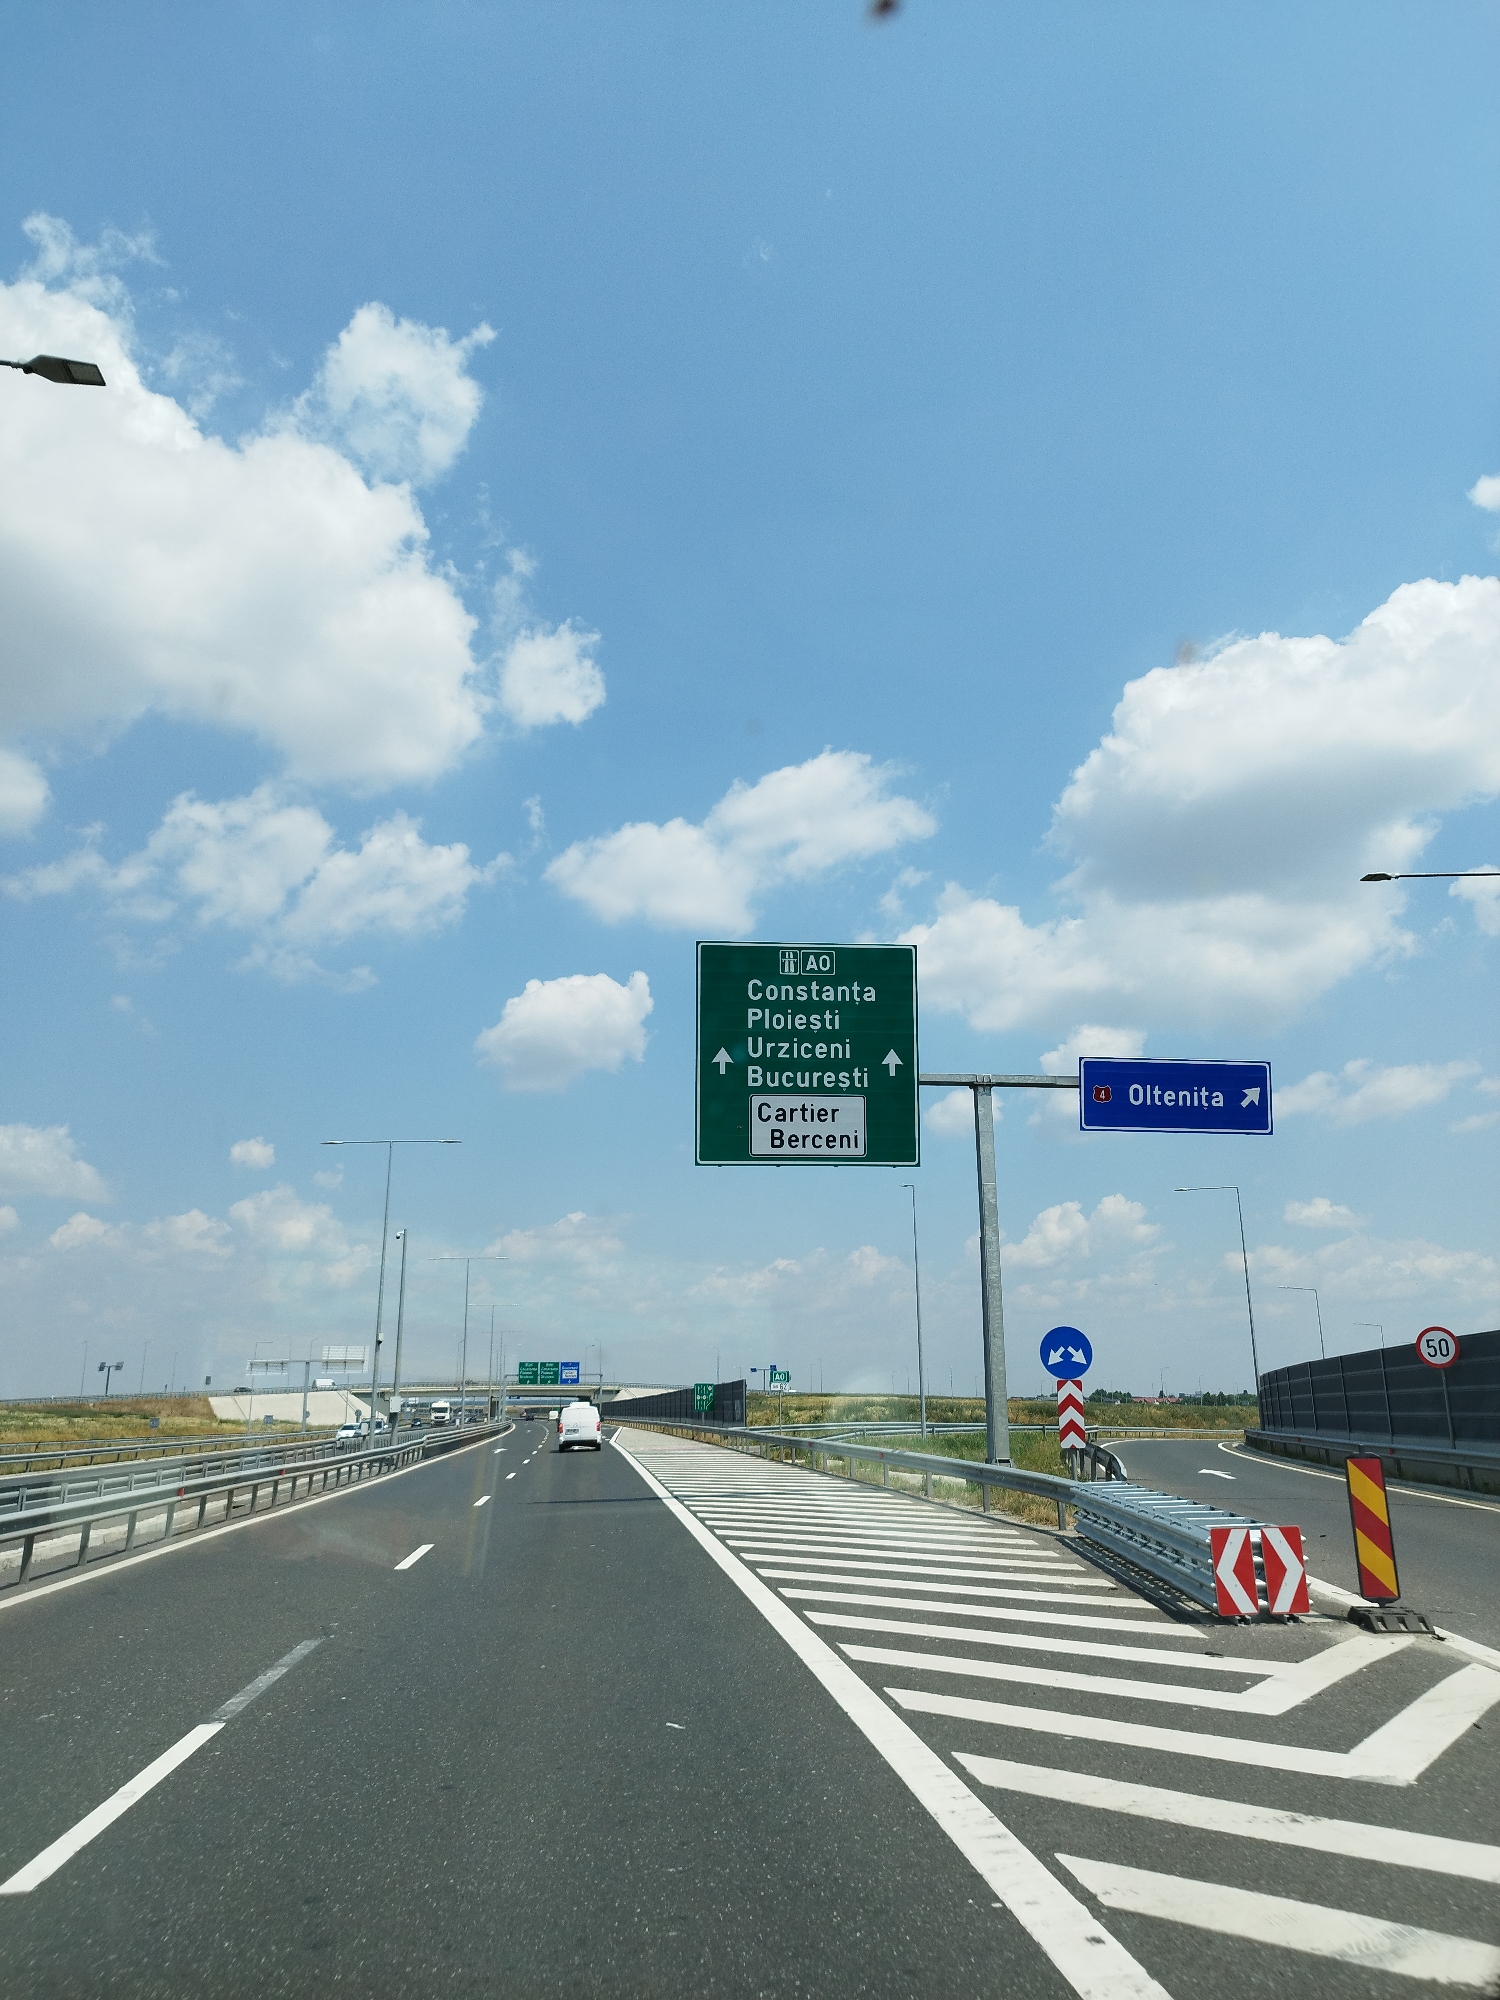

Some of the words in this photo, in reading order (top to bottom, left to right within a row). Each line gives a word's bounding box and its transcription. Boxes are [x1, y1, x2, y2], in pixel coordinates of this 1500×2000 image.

[747, 979, 876, 1005] Constanța
[747, 1008, 840, 1033] Ploiești
[747, 1036, 851, 1059] Urziceni
[747, 1065, 869, 1091] București
[1099, 1089, 1106, 1100] 4
[1128, 1084, 1224, 1110] Oltenița
[757, 1102, 840, 1123] Cartier
[770, 1128, 859, 1149] Berceni
[1425, 1338, 1450, 1358] 50
